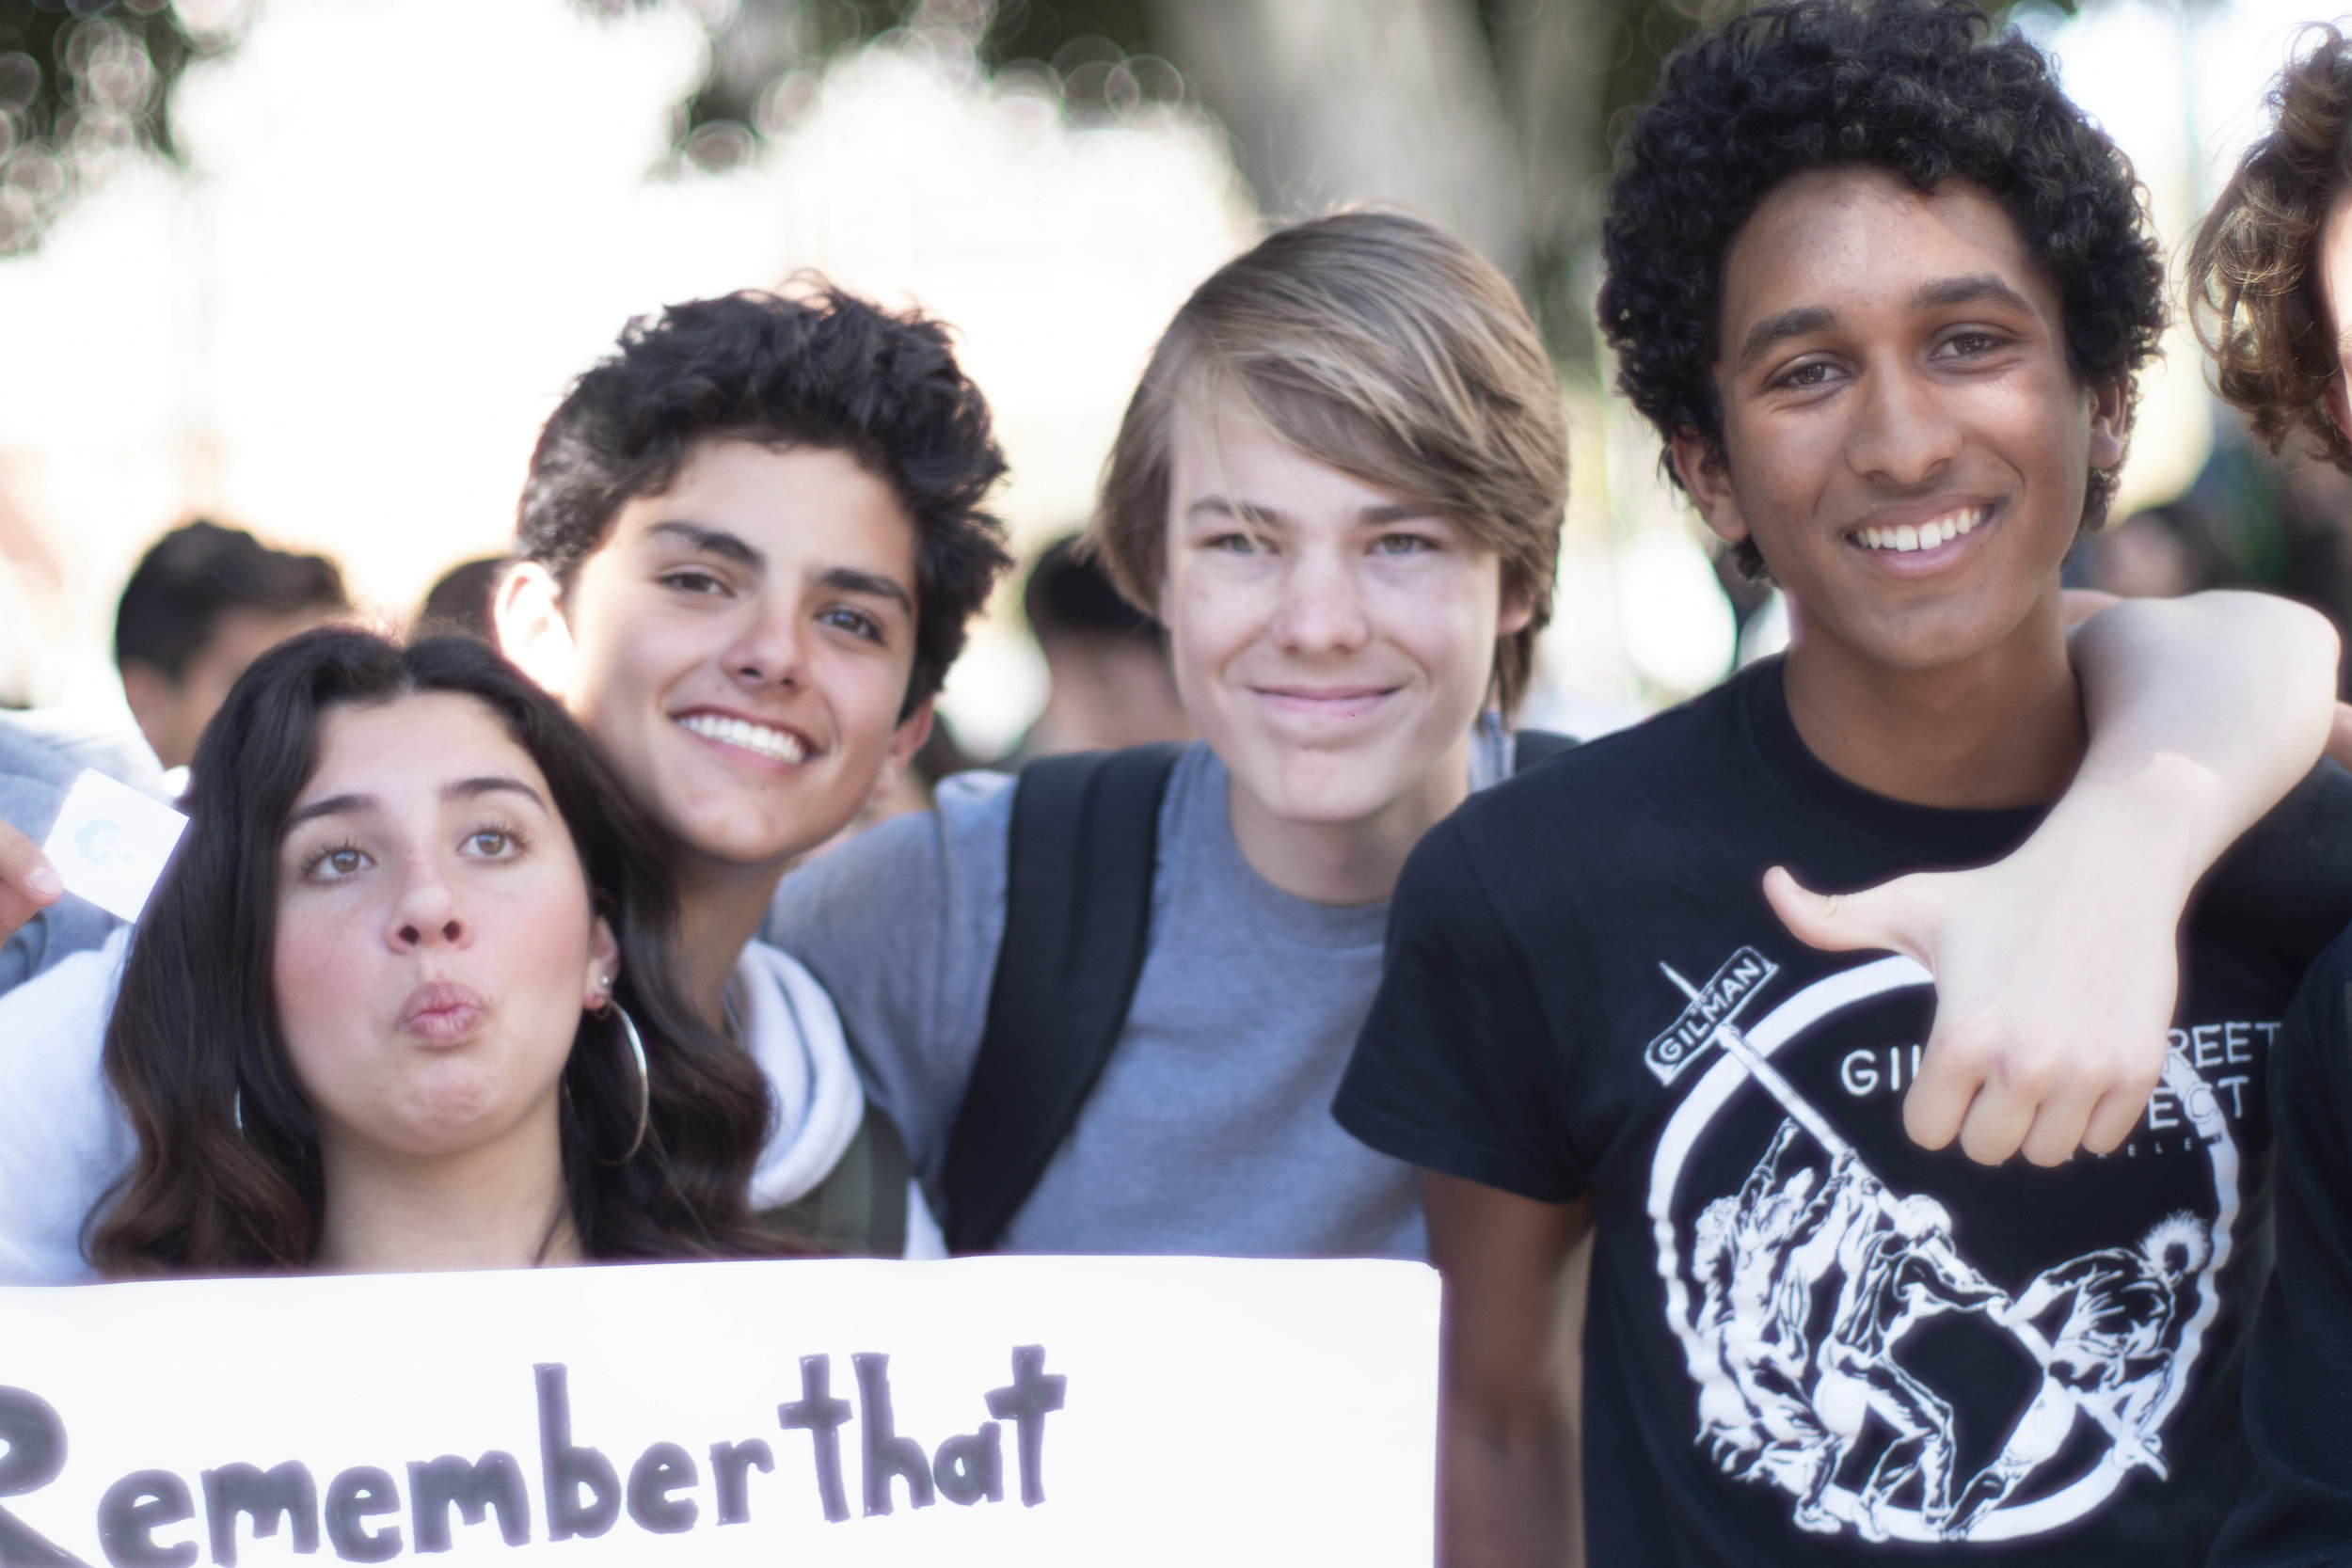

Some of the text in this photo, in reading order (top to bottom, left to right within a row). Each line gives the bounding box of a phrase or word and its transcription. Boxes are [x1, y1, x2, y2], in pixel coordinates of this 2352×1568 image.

[1658, 957, 1762, 1062] GILMAN
[2161, 1022, 2282, 1074] REET
[2147, 1075, 2250, 1131] ECT
[0, 1343, 1068, 1568] Remember that
